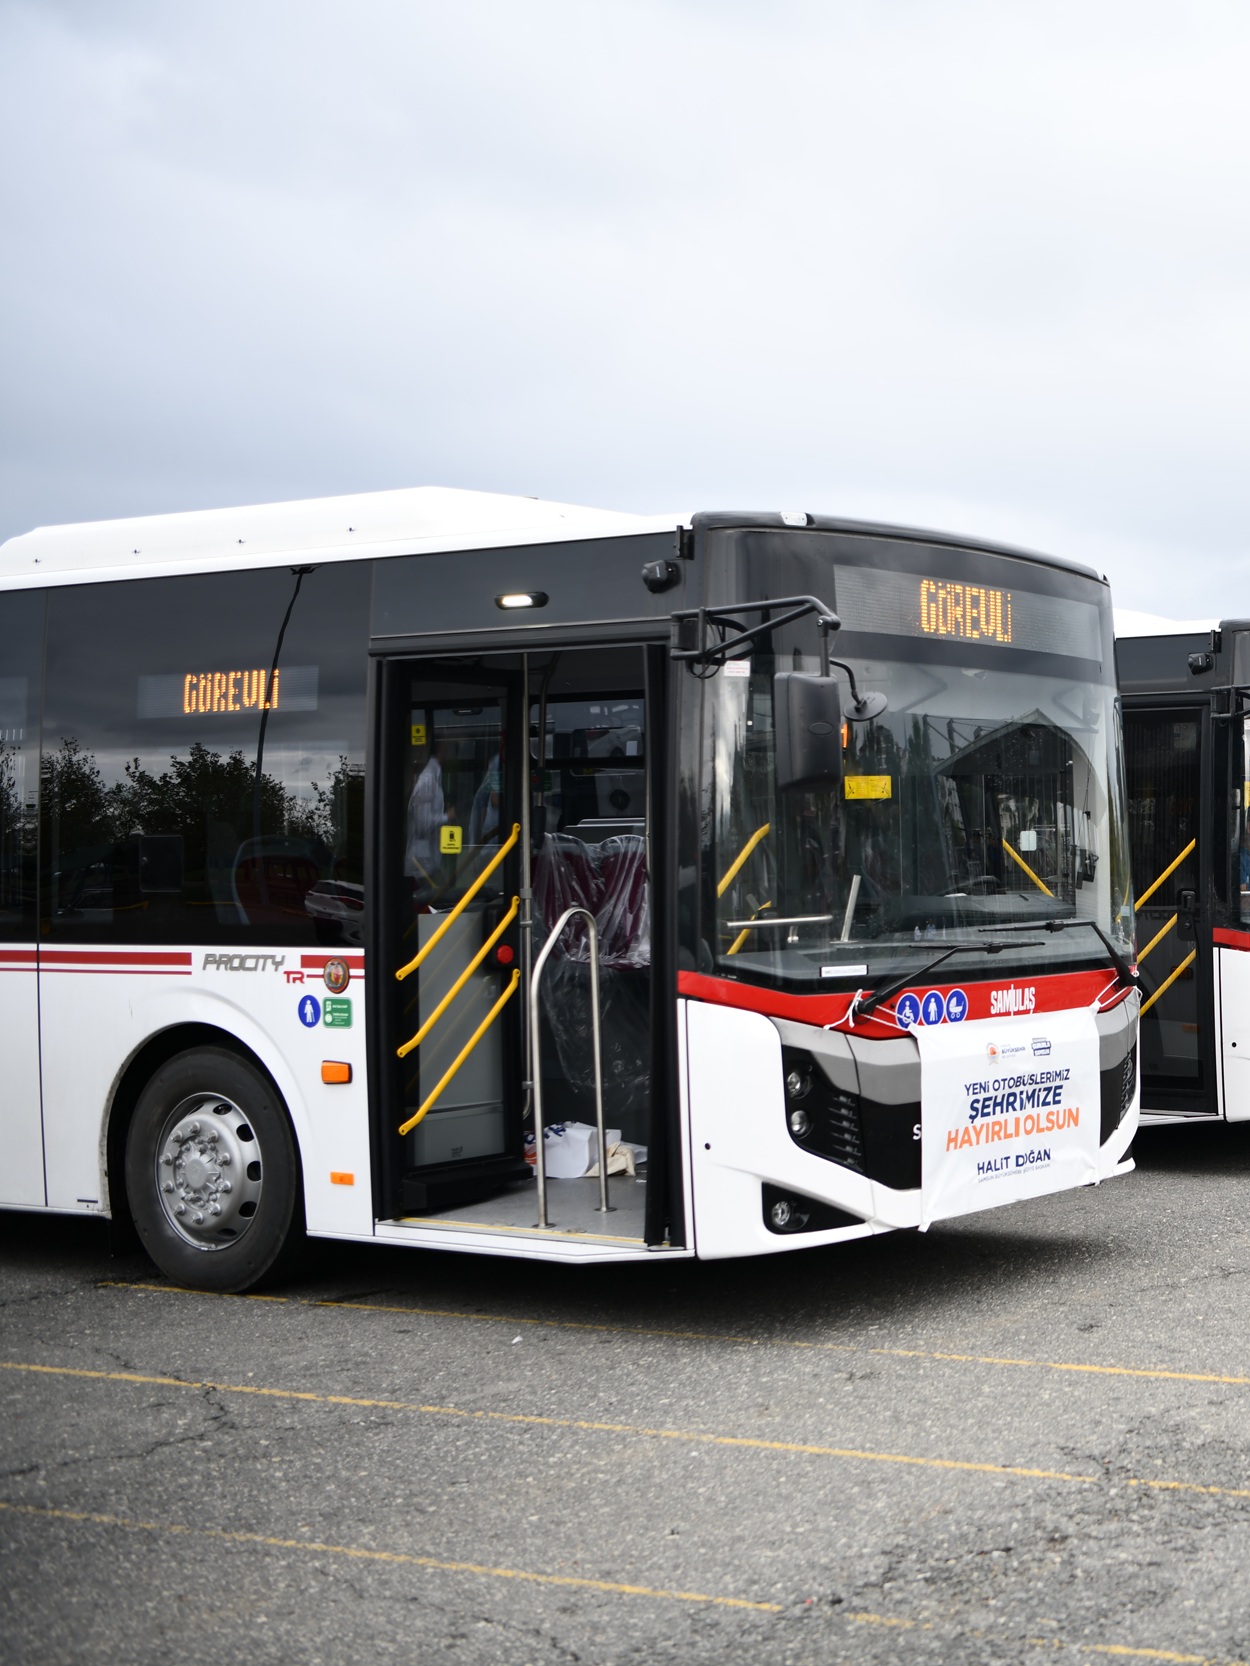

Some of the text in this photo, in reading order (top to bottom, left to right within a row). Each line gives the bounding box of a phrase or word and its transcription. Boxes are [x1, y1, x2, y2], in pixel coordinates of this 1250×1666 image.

[921, 579, 1012, 642] GÖREVLİ
[183, 669, 279, 713] GÖREVLİ
[202, 953, 285, 972] PROCITY
[283, 970, 305, 984] TR
[964, 1069, 1070, 1096] YENİ OTOBÜSLERİMİZ
[968, 1085, 1064, 1124] ŞEHRİMİZE
[945, 1116, 1020, 1152] HAYIRLI
[1023, 1107, 1080, 1136] OLSUN
[977, 1156, 1011, 1175] HALİT
